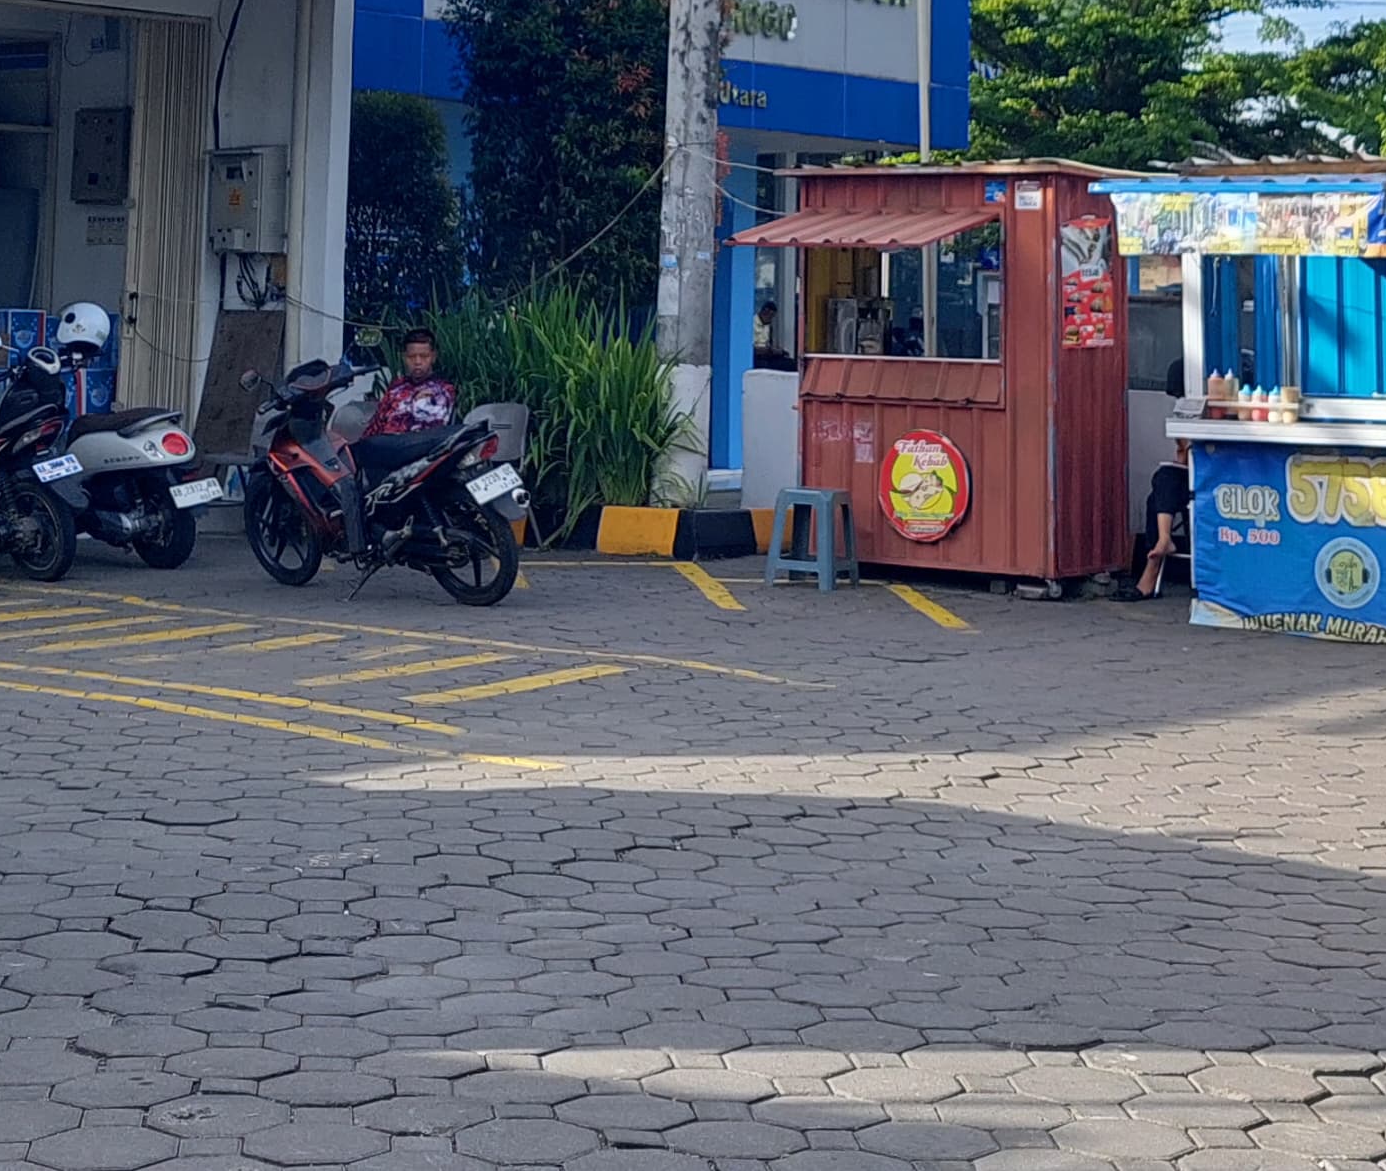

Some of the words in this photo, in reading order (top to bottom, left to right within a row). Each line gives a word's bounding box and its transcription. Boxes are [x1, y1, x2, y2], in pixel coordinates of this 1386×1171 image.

[913, 453, 949, 470] Kebab
[1219, 527, 1242, 545] Rp.
[1247, 529, 1280, 544] 500
